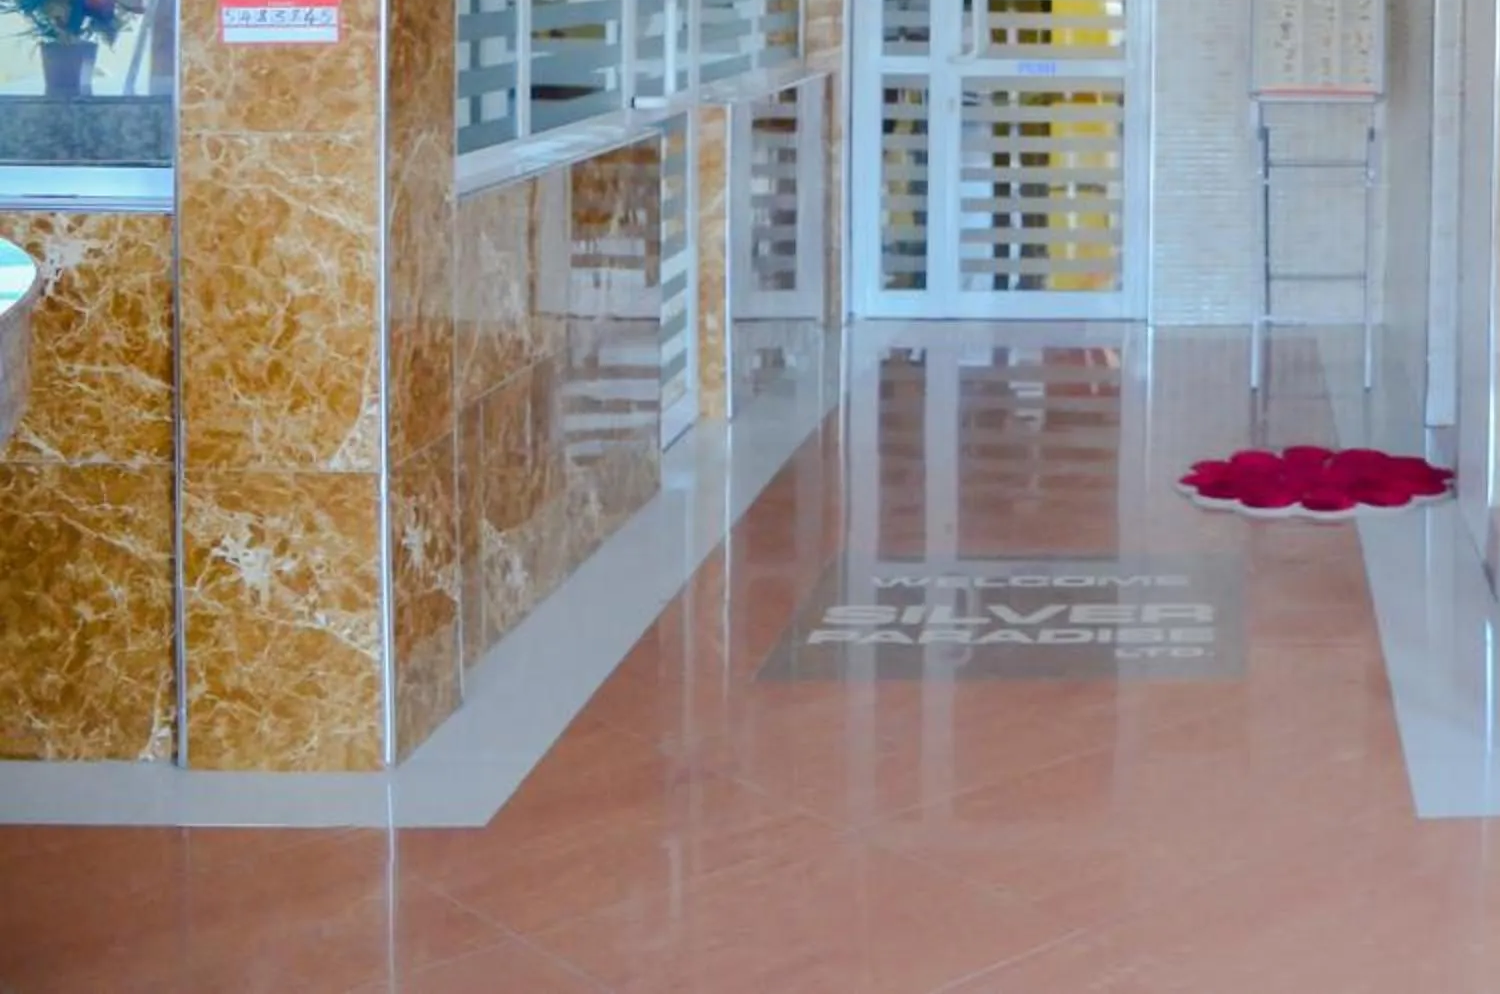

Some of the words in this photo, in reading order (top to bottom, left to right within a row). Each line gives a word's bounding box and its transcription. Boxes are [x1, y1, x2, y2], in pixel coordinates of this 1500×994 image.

[873, 574, 1188, 588] WELCOME
[823, 603, 1215, 625] SILVER
[806, 628, 1216, 644] PARADISE
